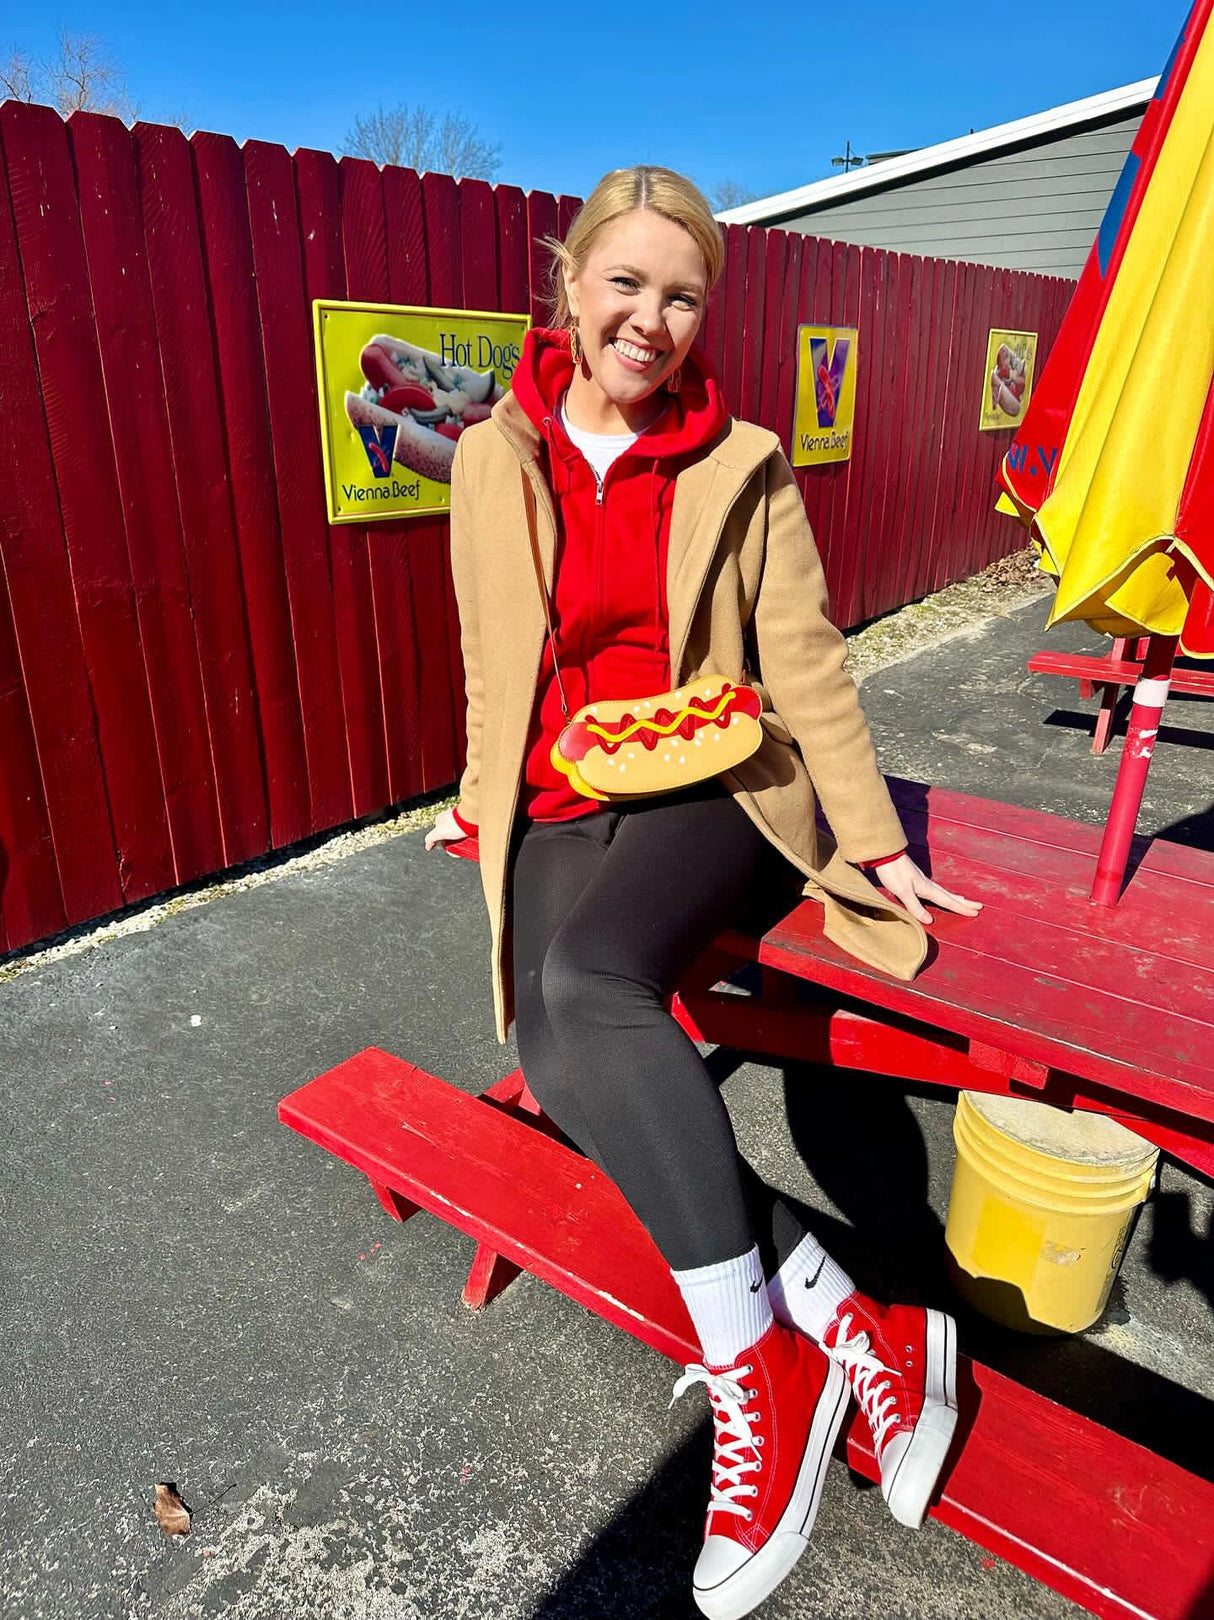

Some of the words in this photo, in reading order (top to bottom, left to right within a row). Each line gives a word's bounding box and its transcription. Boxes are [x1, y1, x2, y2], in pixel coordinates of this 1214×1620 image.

[439, 333, 472, 368] Hot
[801, 433, 829, 452] Vienna
[831, 430, 849, 453] Beef
[342, 483, 390, 501] Vienna
[392, 479, 421, 501] Beef
